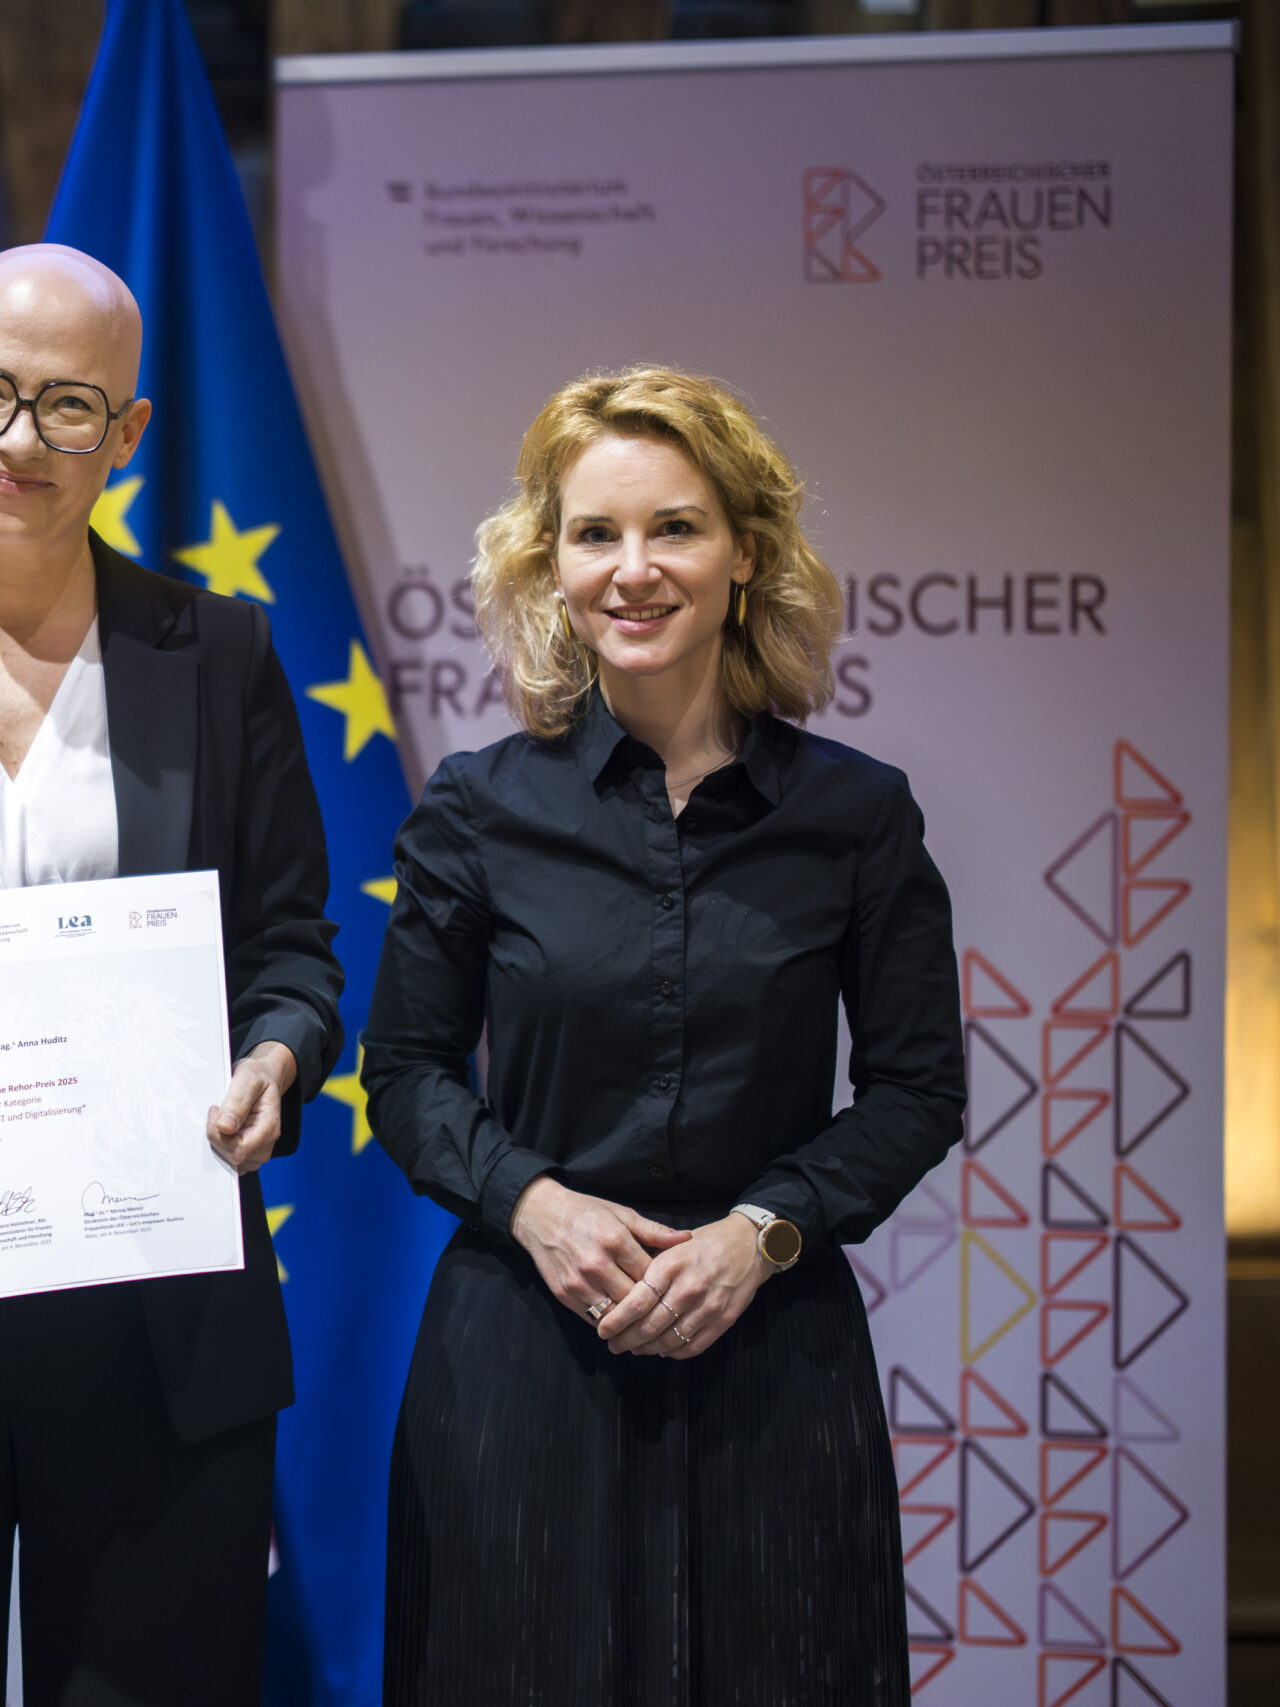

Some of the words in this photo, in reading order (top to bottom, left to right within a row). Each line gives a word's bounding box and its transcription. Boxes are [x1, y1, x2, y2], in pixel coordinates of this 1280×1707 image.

[916, 185, 1112, 231] FRAUEN
[916, 235, 1043, 280] PREIS
[146, 912, 178, 921] FRAUEN
[146, 920, 167, 928] PREIS
[17, 1040, 39, 1048] Anna
[40, 1036, 68, 1045] Huditz
[8, 1080, 56, 1092] Rehor-Preis
[57, 1077, 79, 1086] 2025
[3, 1096, 42, 1109] Kategorie
[7, 1112, 23, 1122] und
